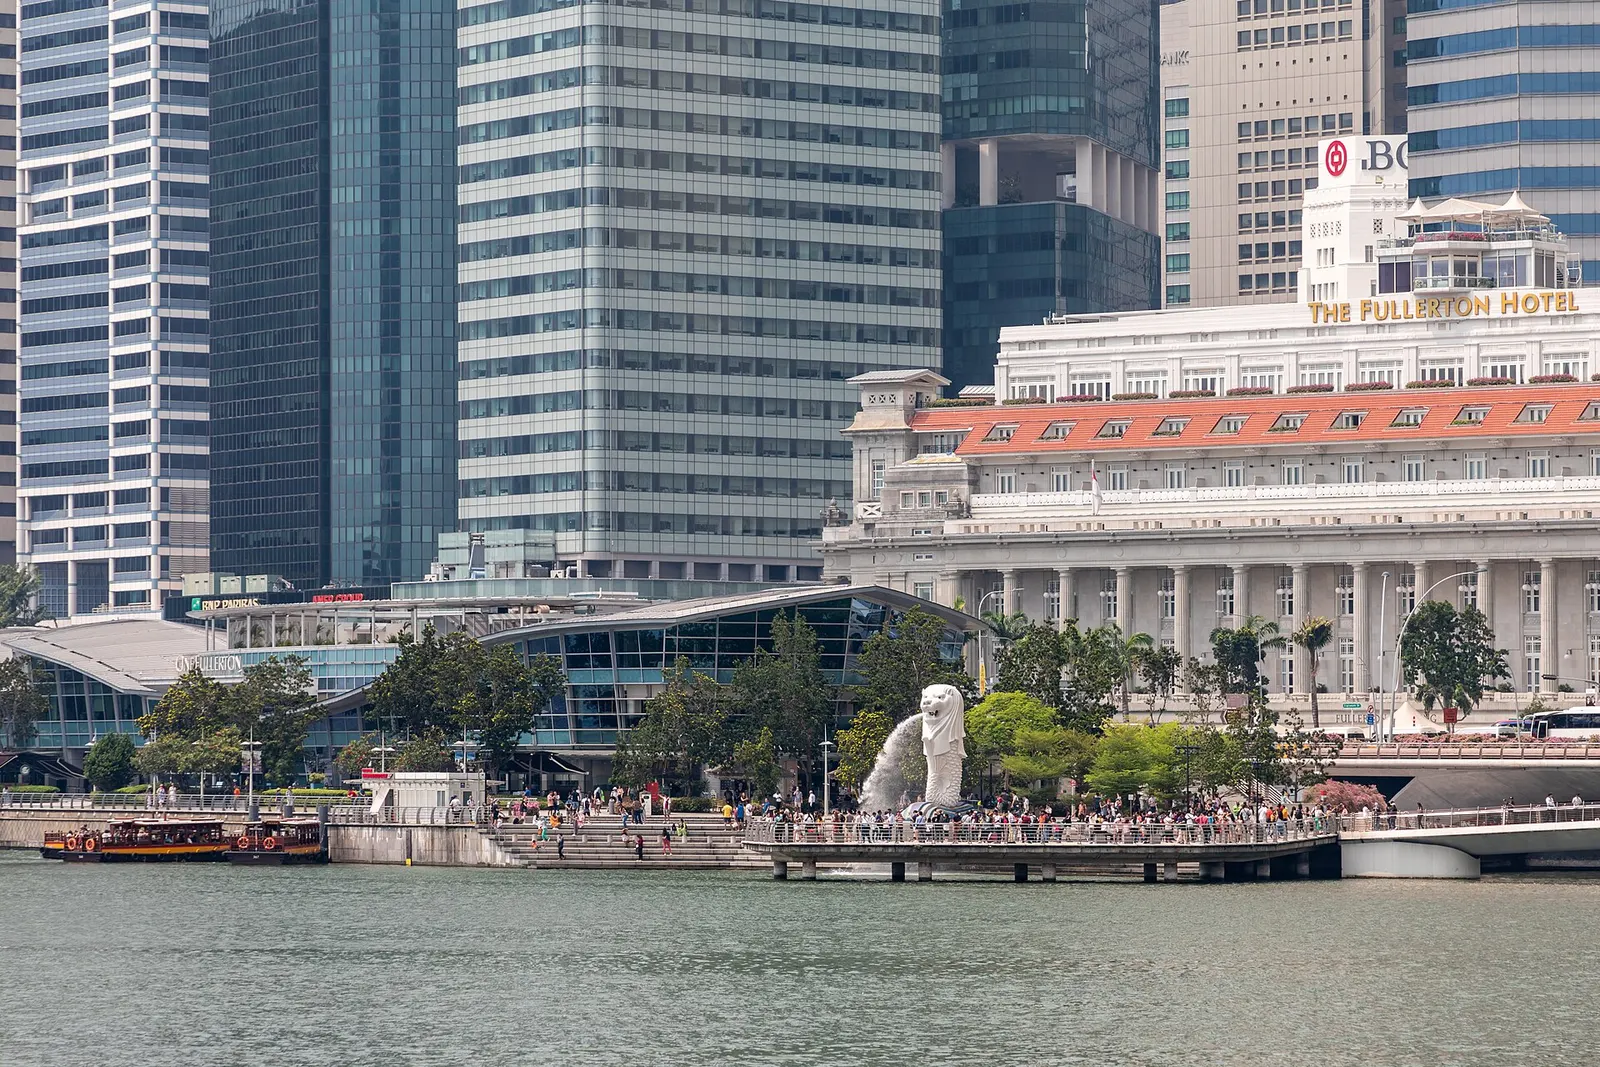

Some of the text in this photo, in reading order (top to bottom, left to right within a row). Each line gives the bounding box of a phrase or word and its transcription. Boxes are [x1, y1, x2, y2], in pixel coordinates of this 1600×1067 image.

[1308, 291, 1579, 324] THE FULLERTON HOTEL
[195, 654, 242, 672] FULLERTON
